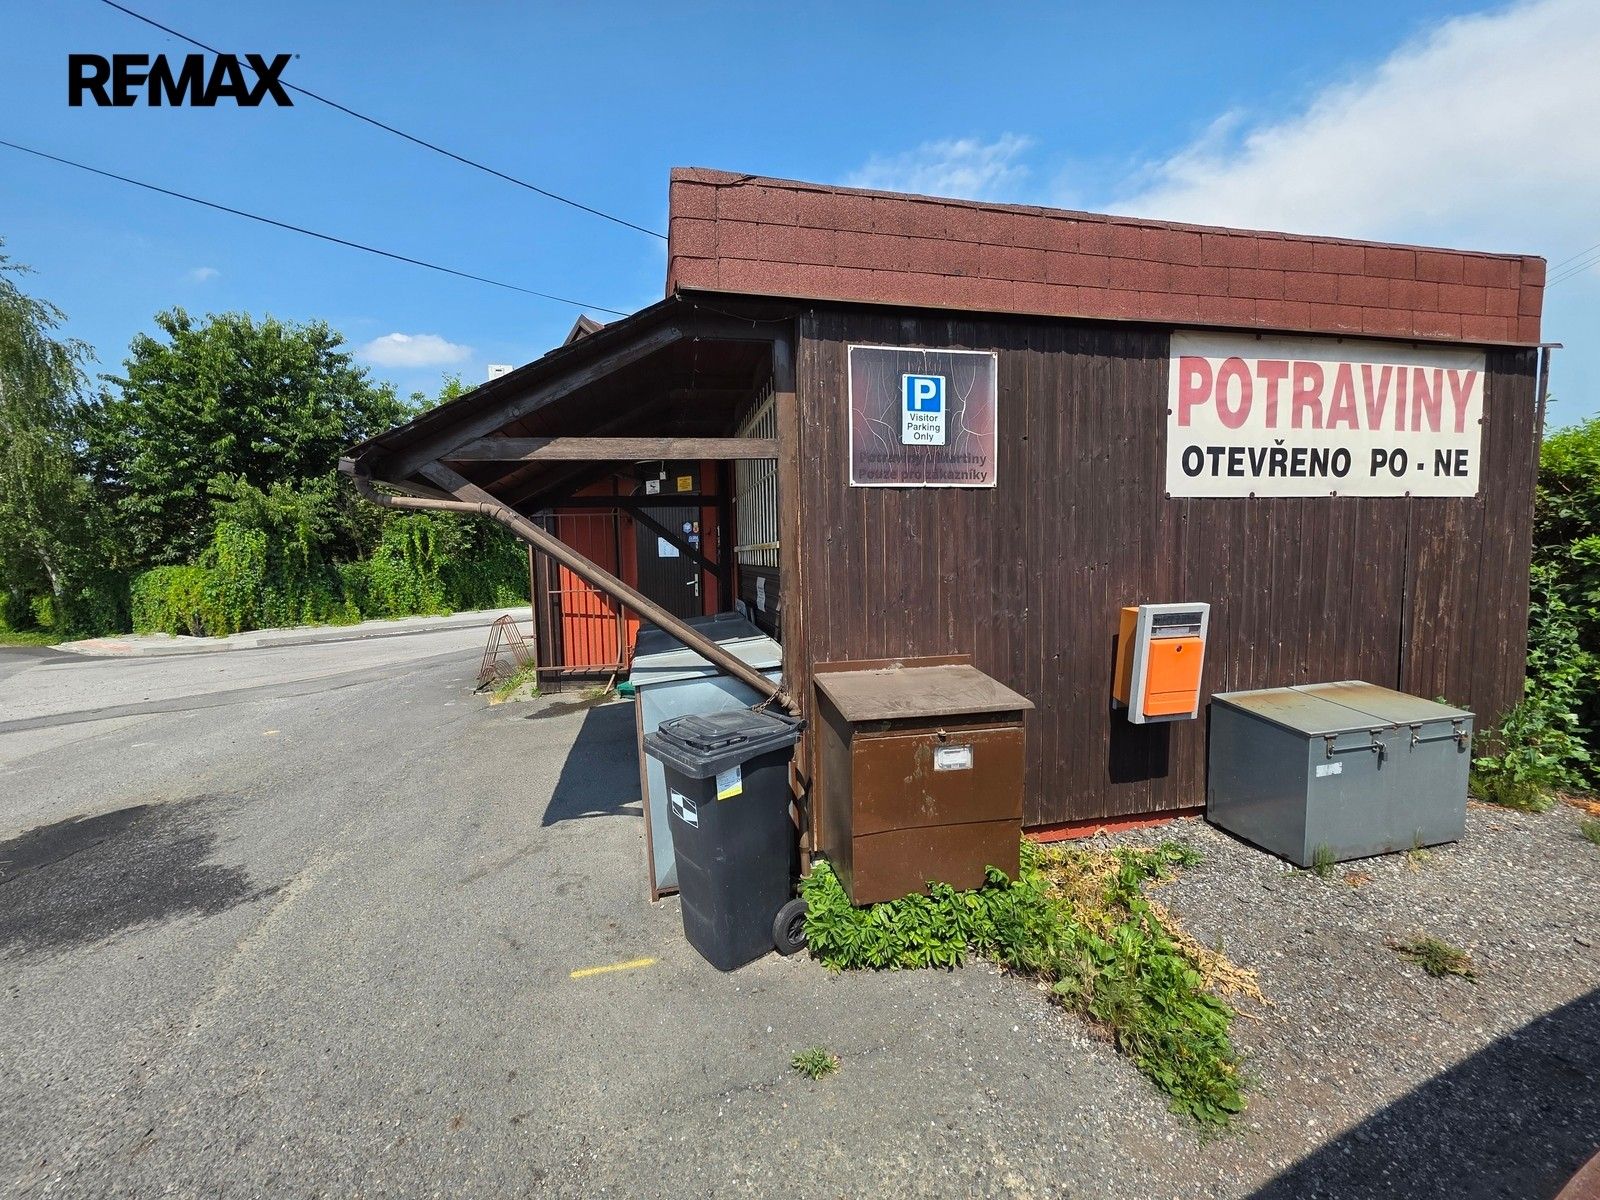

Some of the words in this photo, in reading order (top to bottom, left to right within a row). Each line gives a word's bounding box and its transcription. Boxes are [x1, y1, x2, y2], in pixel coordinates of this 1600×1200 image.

[914, 378, 937, 410] P
[1177, 355, 1477, 433] POTRAVINY
[909, 413, 938, 422] Visitor
[907, 423, 940, 433] Parking
[913, 432, 934, 442] Only
[1181, 439, 1352, 478] OTEVŘENO
[1370, 448, 1408, 478] PO
[1433, 448, 1469, 477] NE
[858, 468, 899, 480] Pouze
[901, 471, 922, 483] pro
[925, 468, 988, 483] zákazníky
